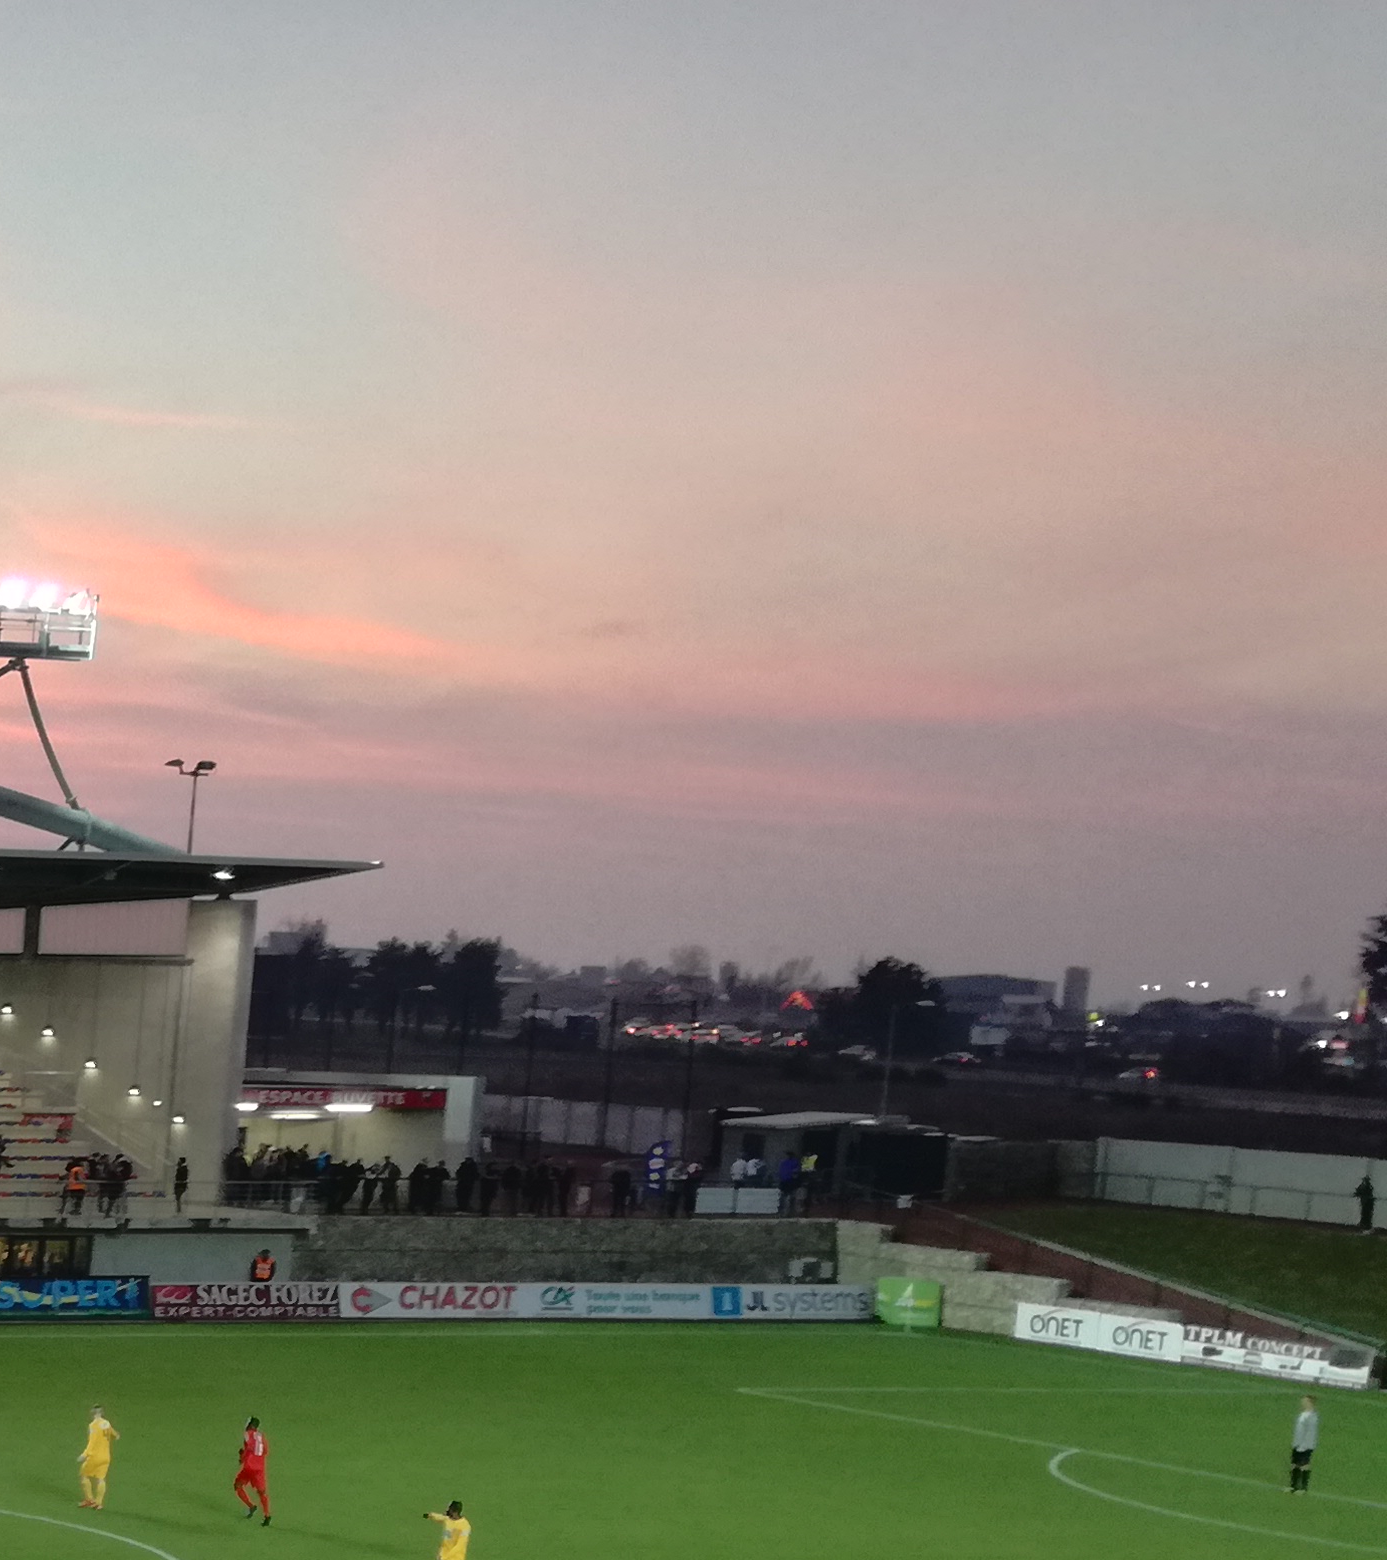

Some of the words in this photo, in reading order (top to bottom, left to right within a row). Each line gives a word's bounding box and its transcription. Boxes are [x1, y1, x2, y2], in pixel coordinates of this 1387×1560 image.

[258, 1090, 325, 1104] ESPACE
[195, 1285, 267, 1305] SAGEC
[269, 1284, 339, 1305] FOREZ
[398, 1285, 518, 1310] CHAZOT
[772, 1288, 873, 1318] systems
[154, 1306, 339, 1318] EXPERT-COMPTABLE
[1029, 1314, 1083, 1339] ONET
[1112, 1324, 1169, 1352] ONET
[1186, 1325, 1245, 1347] TPLM
[1246, 1337, 1324, 1360] CONCEPT
